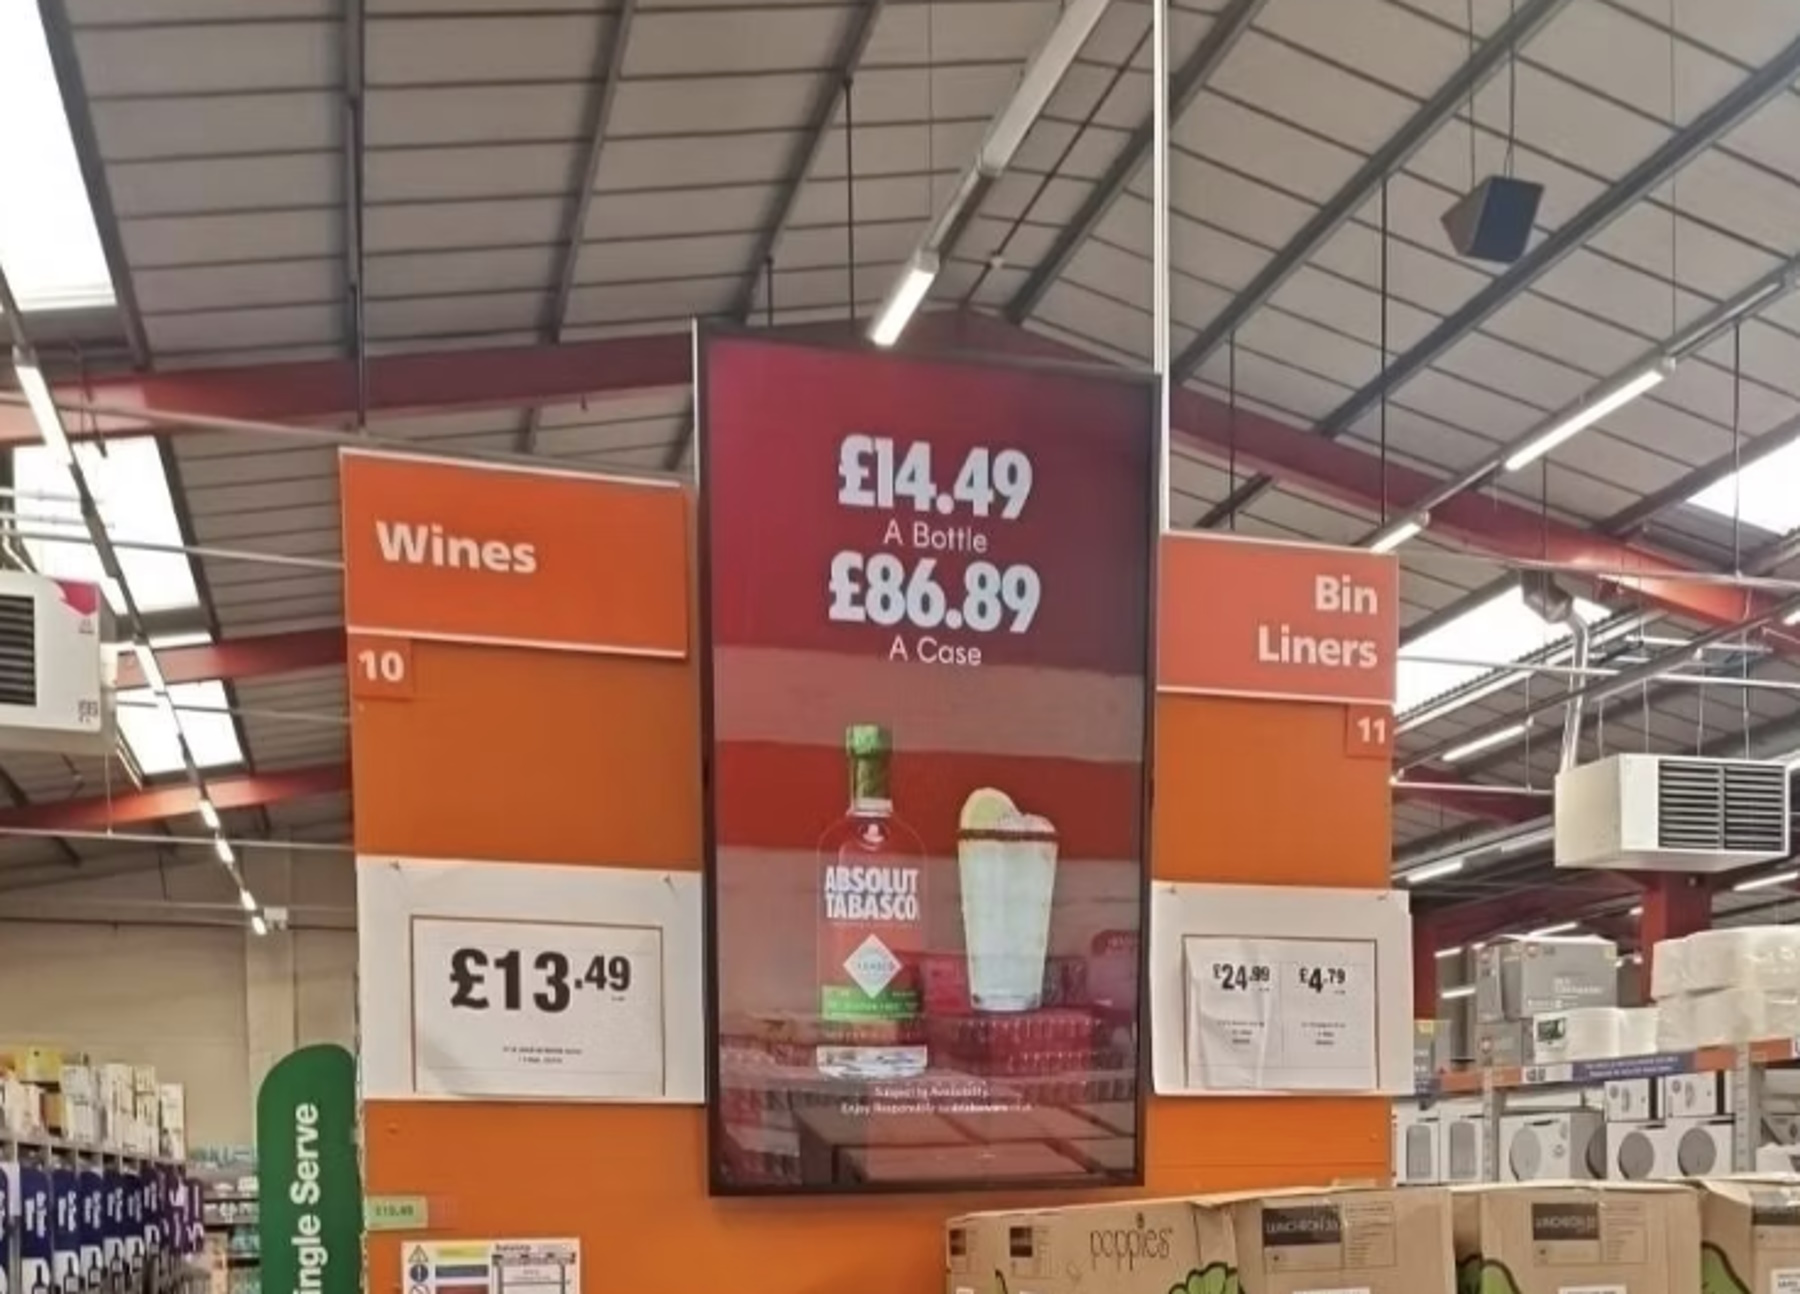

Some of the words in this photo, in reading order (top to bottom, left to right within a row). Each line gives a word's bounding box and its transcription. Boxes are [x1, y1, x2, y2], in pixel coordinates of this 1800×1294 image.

[837, 433, 1034, 519] £14.49
[376, 520, 537, 574] Wines
[883, 520, 903, 545] A
[913, 522, 988, 552] Bottle
[828, 550, 1042, 634] £86.89
[1315, 574, 1378, 615] Bin
[888, 635, 908, 661] A
[916, 637, 982, 667] Case
[1258, 623, 1378, 669] Liners
[358, 650, 405, 682] 10
[1357, 716, 1386, 744] 11
[824, 866, 919, 894] ABSOLUT
[826, 893, 919, 920] TABASCO
[449, 948, 632, 1013] £13.49
[1213, 963, 1270, 991] £24.99
[1300, 967, 1346, 993] £4.79
[289, 1102, 321, 1206] Serve
